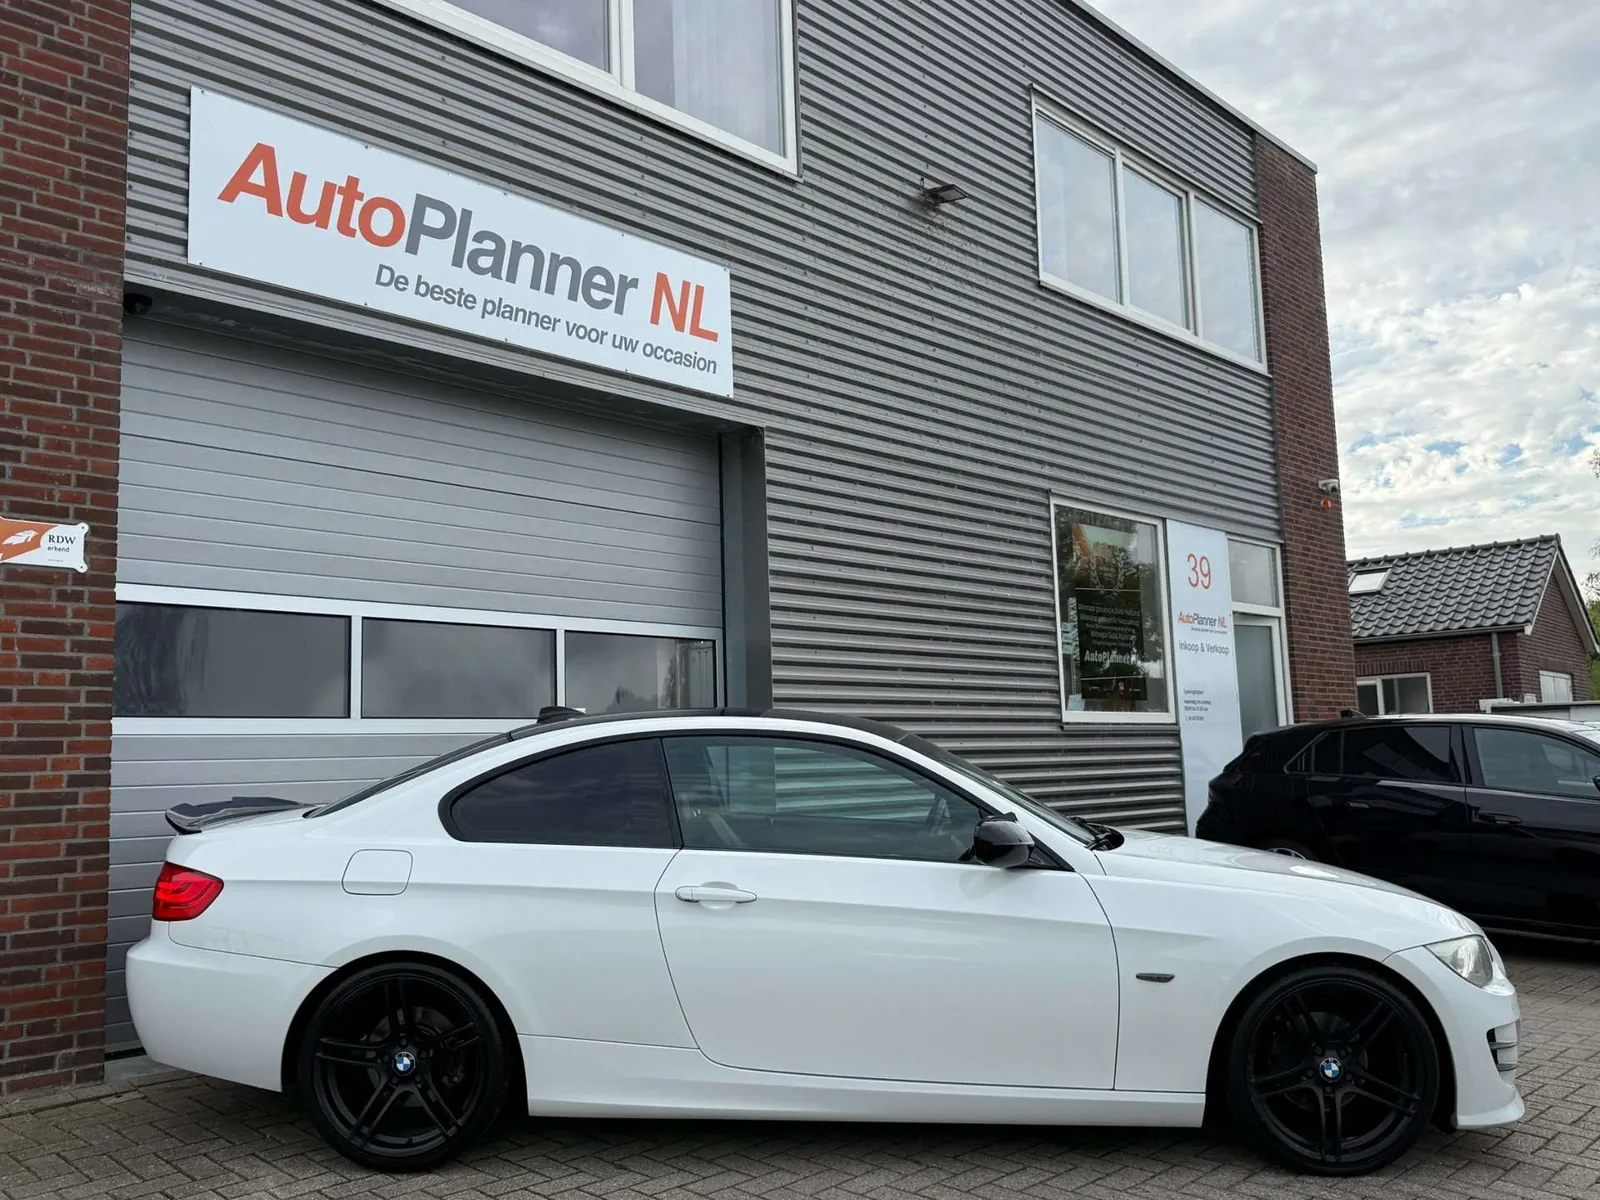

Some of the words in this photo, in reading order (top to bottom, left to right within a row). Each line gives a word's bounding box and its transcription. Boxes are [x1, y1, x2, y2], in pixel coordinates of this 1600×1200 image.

[216, 142, 639, 316] AutoPlanner
[649, 271, 719, 343] NL
[375, 263, 409, 292] De
[414, 274, 477, 310] beste
[481, 297, 561, 333] planner
[565, 320, 608, 346] voor
[611, 333, 640, 353] uw
[642, 342, 718, 375] occasion
[48, 534, 77, 545] RDW
[47, 545, 70, 553] erkend
[1187, 553, 1212, 590] 39
[1178, 611, 1217, 627] AutoPlanner
[1179, 640, 1199, 654] Inkoop
[1200, 642, 1205, 652] &
[1205, 643, 1230, 657] Verkoop
